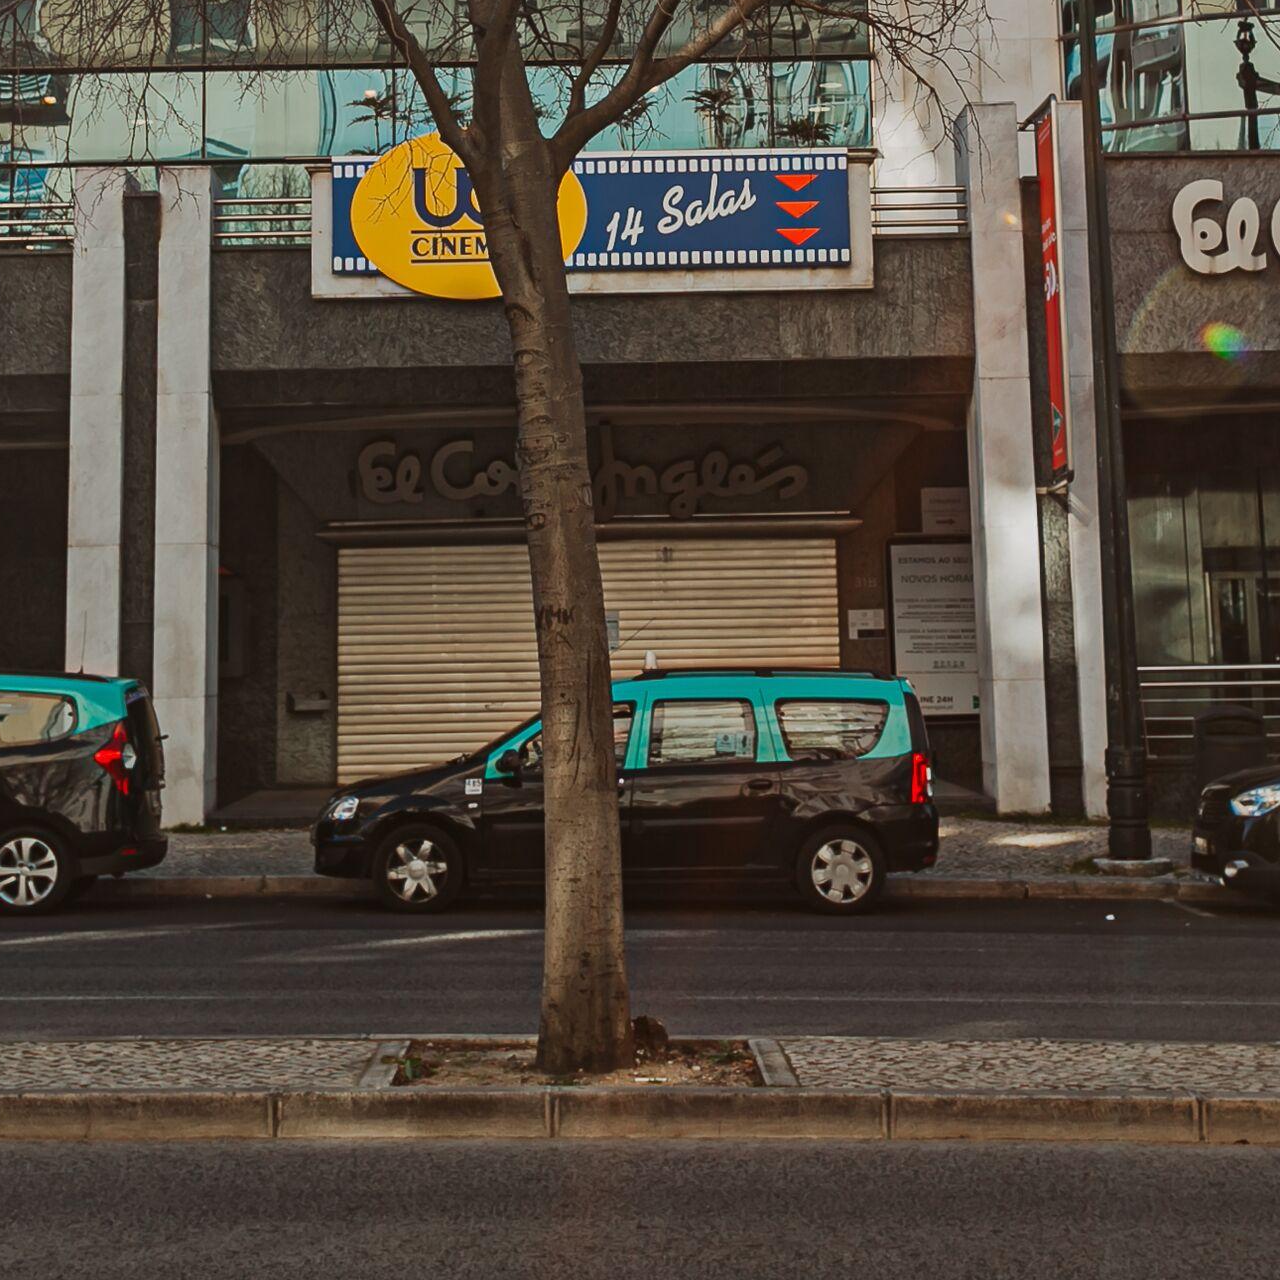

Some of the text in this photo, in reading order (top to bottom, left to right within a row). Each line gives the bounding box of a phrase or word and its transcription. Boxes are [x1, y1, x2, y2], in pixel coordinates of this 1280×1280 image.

[606, 173, 757, 252] 14 Salas
[1172, 179, 1267, 274] El
[411, 236, 489, 257] CINEM
[900, 574, 937, 584] NOVOS
